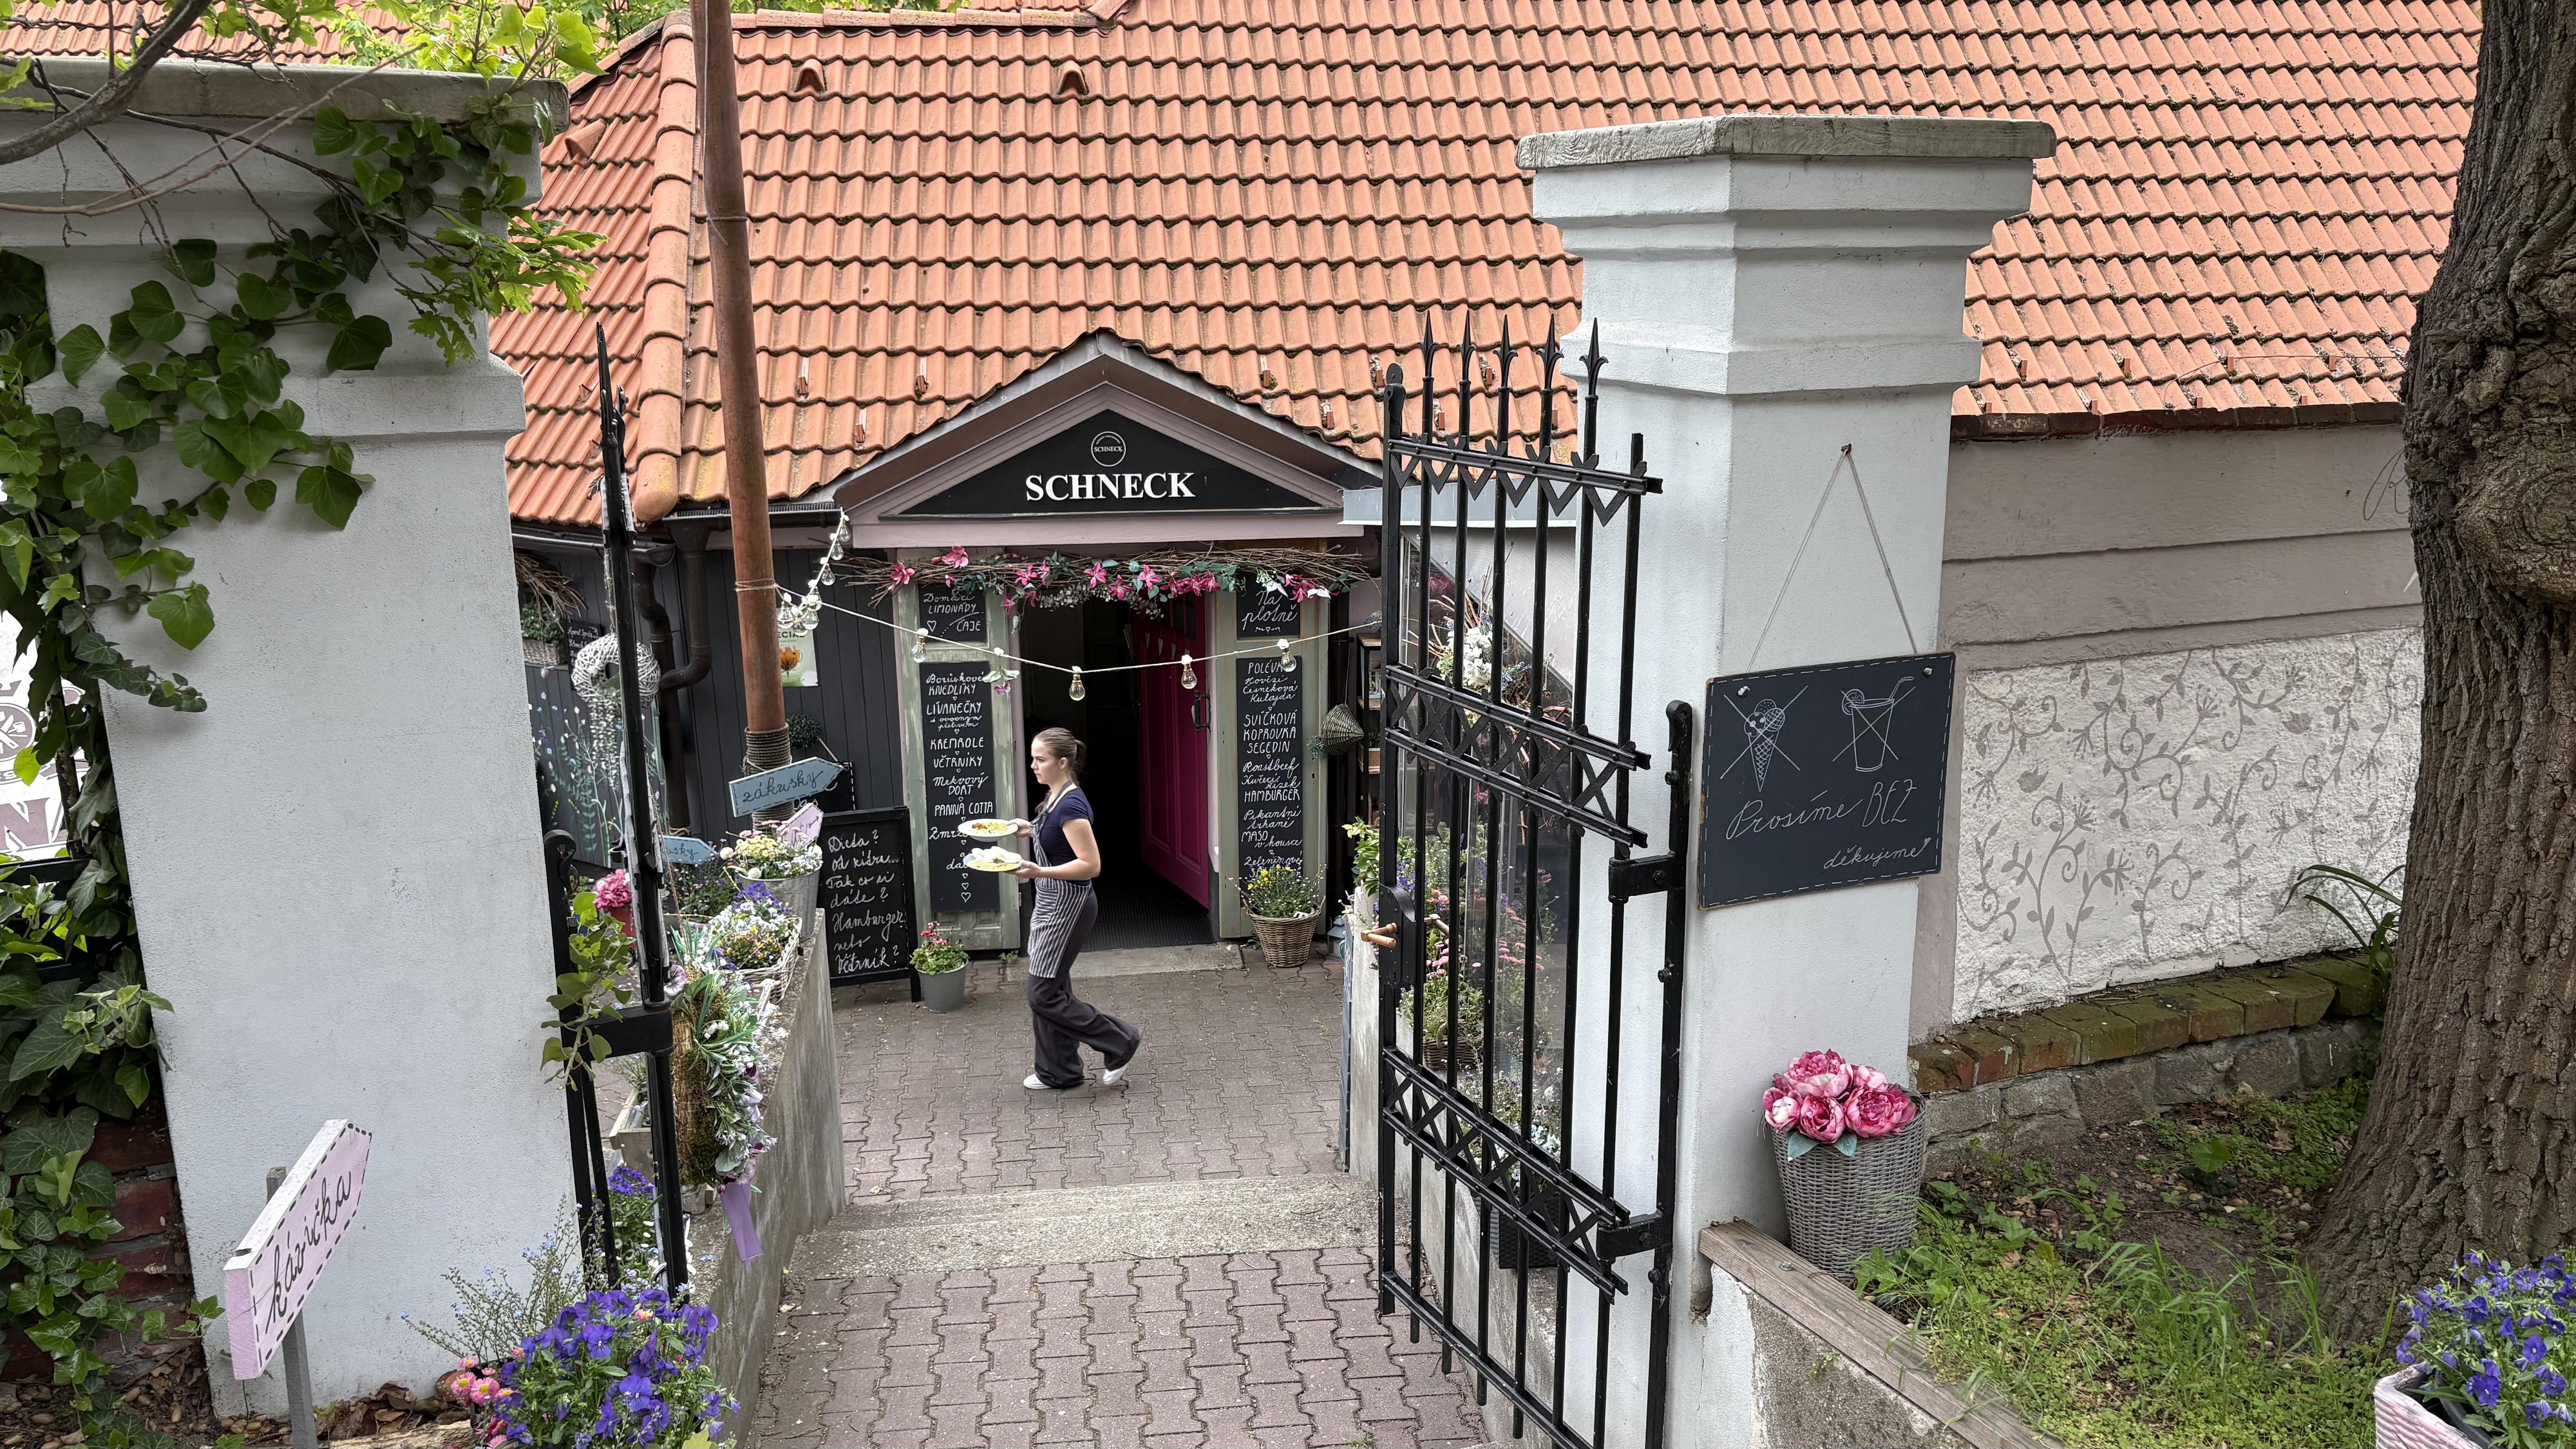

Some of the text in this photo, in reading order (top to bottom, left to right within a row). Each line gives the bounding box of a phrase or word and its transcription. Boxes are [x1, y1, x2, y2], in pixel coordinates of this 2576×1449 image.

[1026, 473, 1195, 501] SCHNECK
[1256, 590, 1283, 605] Na
[929, 602, 976, 614] LIMONÁDY
[1242, 603, 1298, 630] plotně
[956, 619, 981, 632] ČAJE
[1248, 659, 1284, 674] POLÉVK
[1245, 675, 1289, 685] Hovězí
[929, 683, 976, 696] KNEDLÍKY
[1250, 692, 1296, 706] Kulajda
[927, 700, 982, 715] LÍVANEČKY
[1244, 709, 1298, 727] SVÍČKOVÁ
[1244, 726, 1296, 741] KOPROVKA
[930, 737, 985, 750] KREMROLE
[1247, 741, 1290, 753] SEGEDIN
[933, 752, 983, 768] VĚTRNÍKY
[1243, 757, 1300, 779] Roastbeef
[743, 770, 824, 802] zákusky
[933, 772, 989, 788] Mrkvový
[948, 784, 974, 795] DORT
[1244, 789, 1300, 802] HAMBURGER
[934, 801, 993, 817] PANNA COTTA
[1244, 805, 1301, 820] Pikantní
[1726, 779, 1917, 839] Prosíme BEZ
[1247, 817, 1294, 829] trhané
[1241, 831, 1268, 842] MASO
[1823, 843, 1924, 869] děkujeme
[826, 875, 855, 889] Tak
[265, 1171, 351, 1334] kávička
